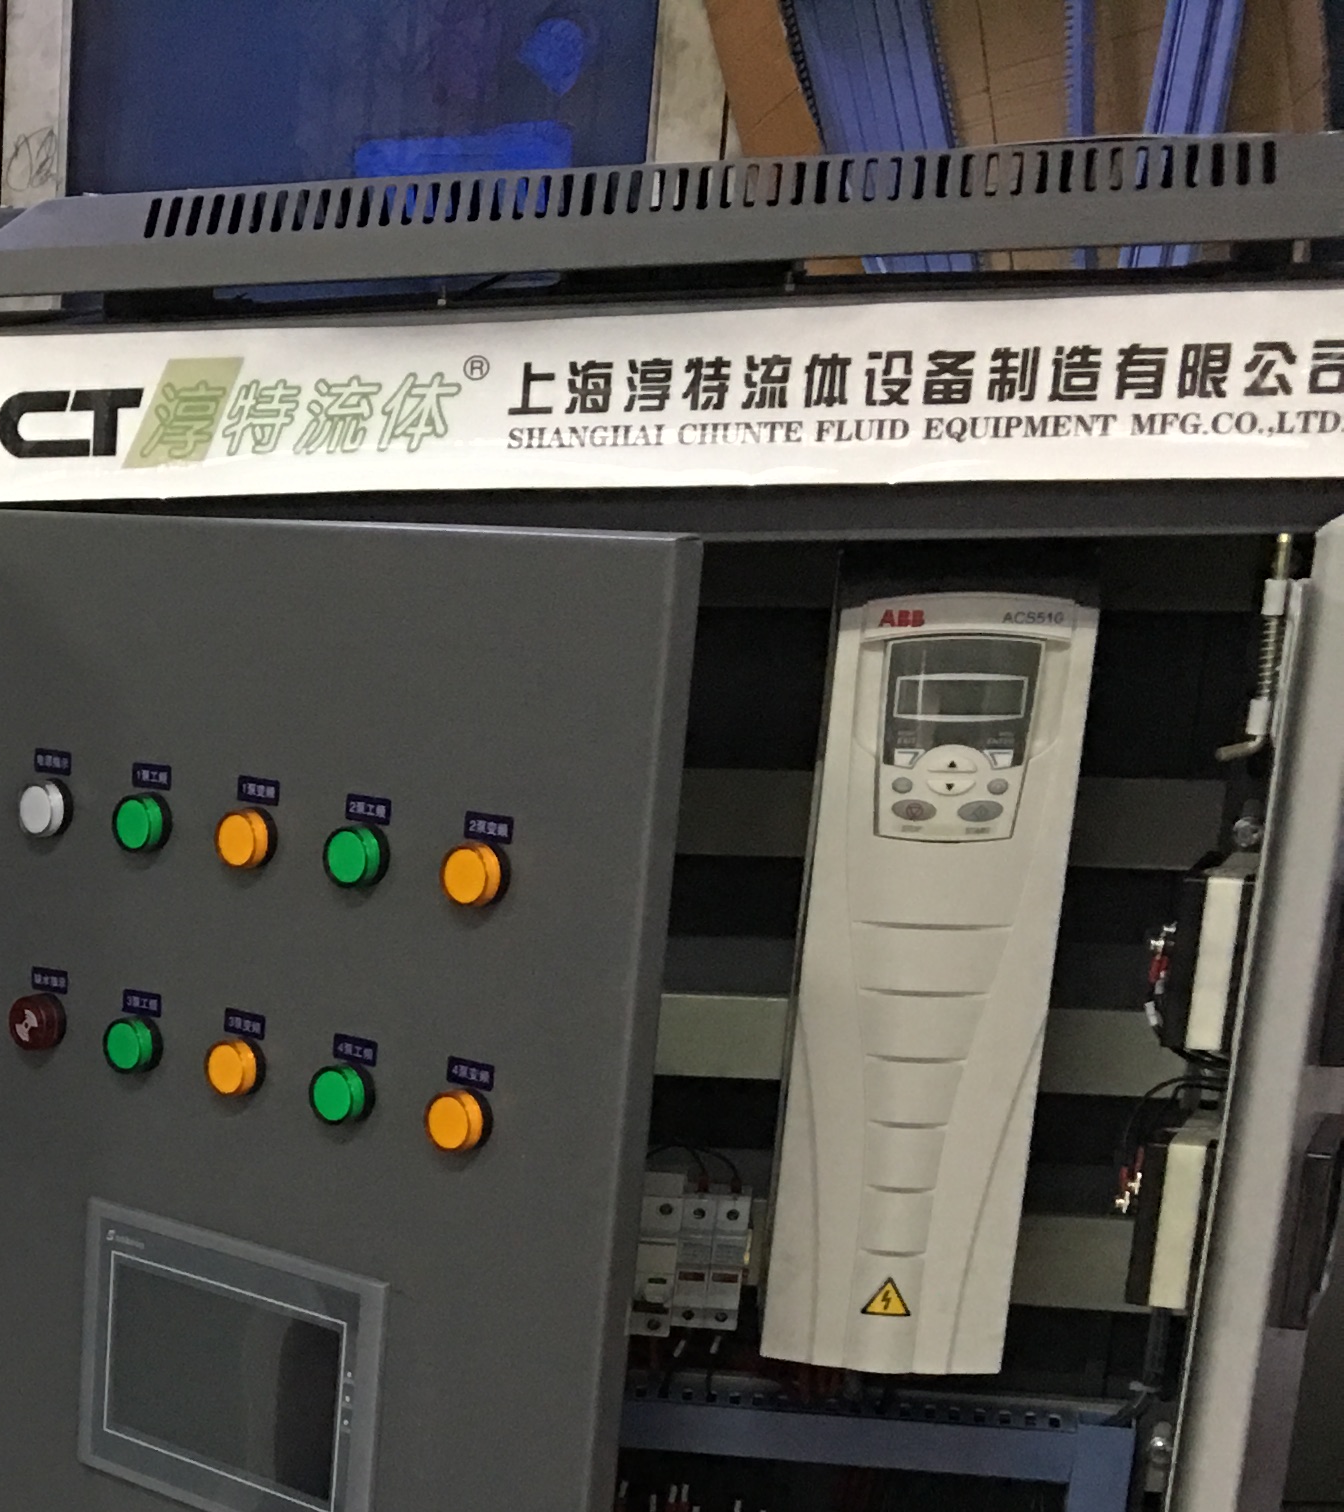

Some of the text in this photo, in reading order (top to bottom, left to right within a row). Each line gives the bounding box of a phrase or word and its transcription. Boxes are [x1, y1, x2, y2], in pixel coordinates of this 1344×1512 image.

[140, 372, 462, 459] 淳特流体
[507, 424, 666, 449] SHANGHAI
[677, 421, 803, 446] CHUNTE
[814, 419, 909, 443] FLUID
[922, 413, 1117, 443] EQUIPMENT
[878, 609, 1064, 627] ABB ACS510
